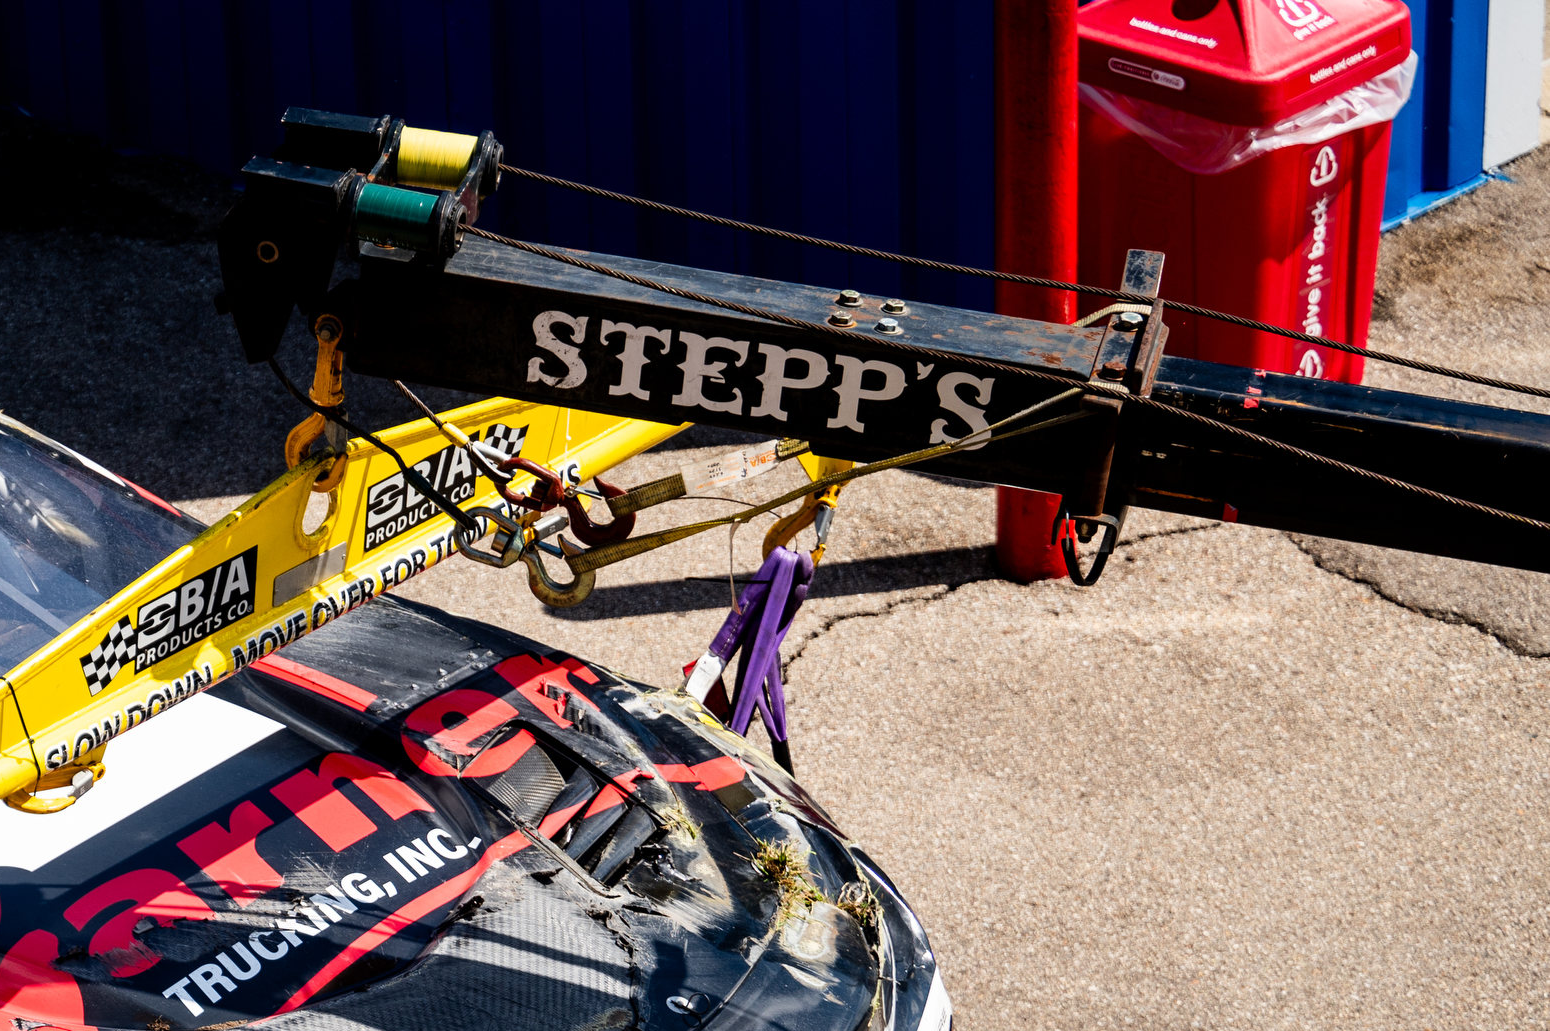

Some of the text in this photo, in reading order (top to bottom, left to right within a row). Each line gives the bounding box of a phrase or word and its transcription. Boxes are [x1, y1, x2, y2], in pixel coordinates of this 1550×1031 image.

[1129, 17, 1218, 49] bottles and cans only
[1310, 45, 1377, 84] bottles and cans only
[526, 309, 996, 451] STEPP'S
[365, 501, 441, 549] PRODUCT
[45, 711, 123, 771] SLOW
[126, 664, 214, 729] DOWN
[230, 609, 308, 674] MOVE
[310, 576, 374, 634] OVER
[380, 548, 427, 593] FOR
[135, 616, 223, 671] PRODUCTS
[162, 825, 484, 1017] TRUCKING, INC.
